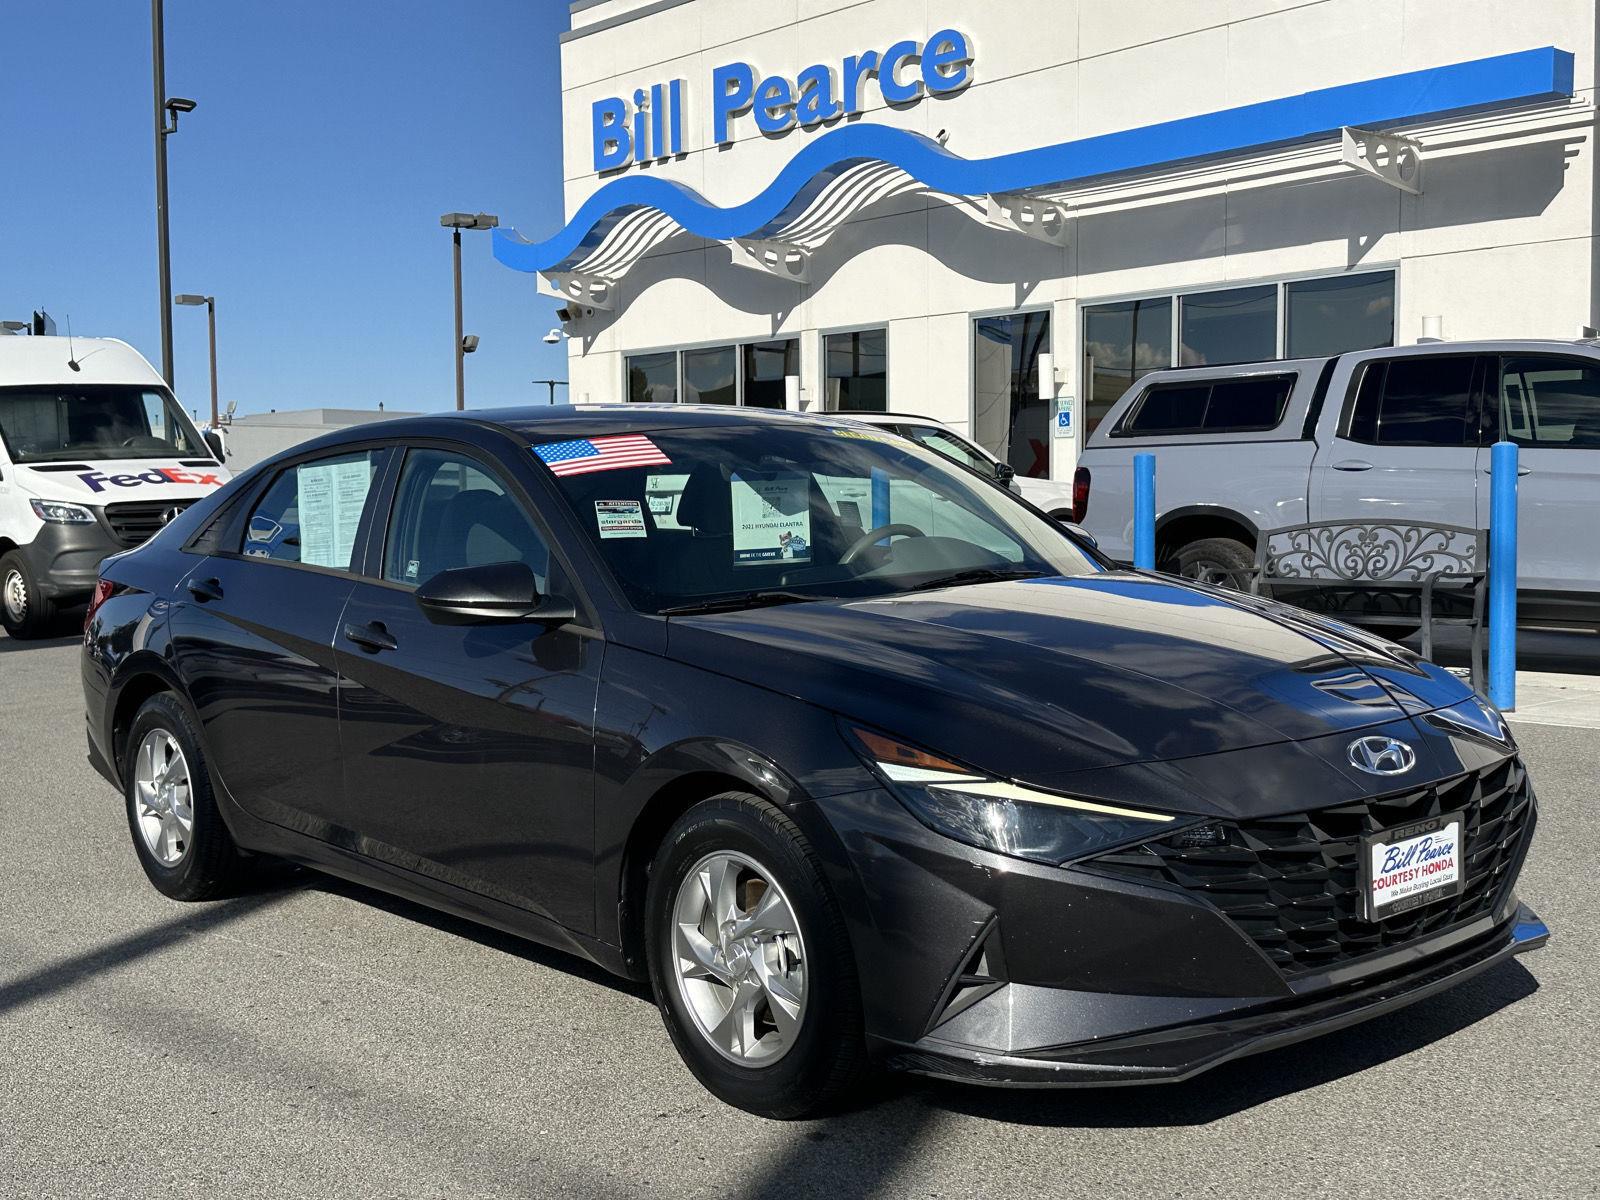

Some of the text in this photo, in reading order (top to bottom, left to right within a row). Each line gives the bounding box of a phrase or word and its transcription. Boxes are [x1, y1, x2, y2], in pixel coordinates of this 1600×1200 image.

[592, 29, 974, 174] Bill Pearce
[77, 468, 225, 493] FedEx
[1394, 821, 1436, 839] RENO
[1381, 837, 1453, 873] Bill Pearce
[1372, 858, 1454, 891] COURTESY HONDA
